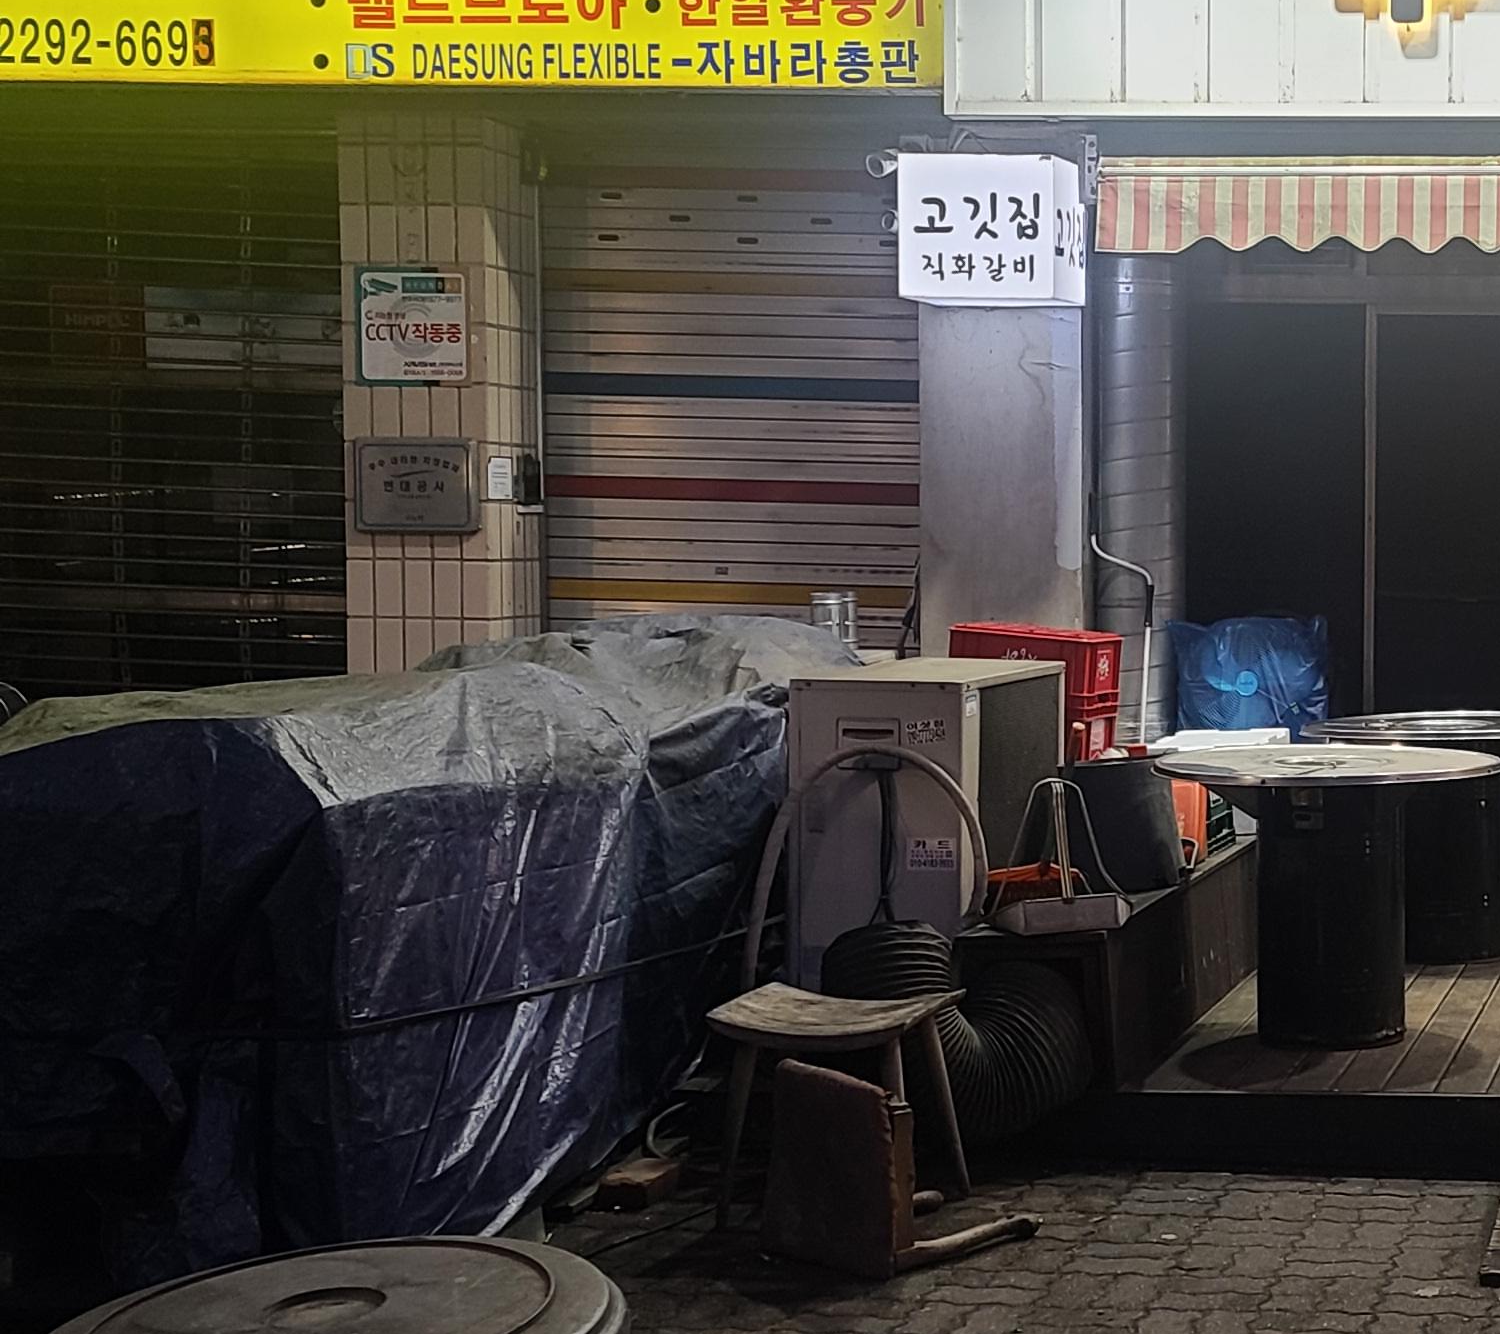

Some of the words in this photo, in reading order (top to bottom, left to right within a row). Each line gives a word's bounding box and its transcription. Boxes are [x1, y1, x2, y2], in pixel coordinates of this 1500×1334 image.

[412, 44, 533, 80] DAESUNG
[543, 42, 662, 80] FLEXIBLE
[913, 192, 1041, 240] 고깃집
[921, 252, 1035, 282] 직화갈비
[365, 323, 409, 342] CCTV
[412, 322, 463, 344] 작동중
